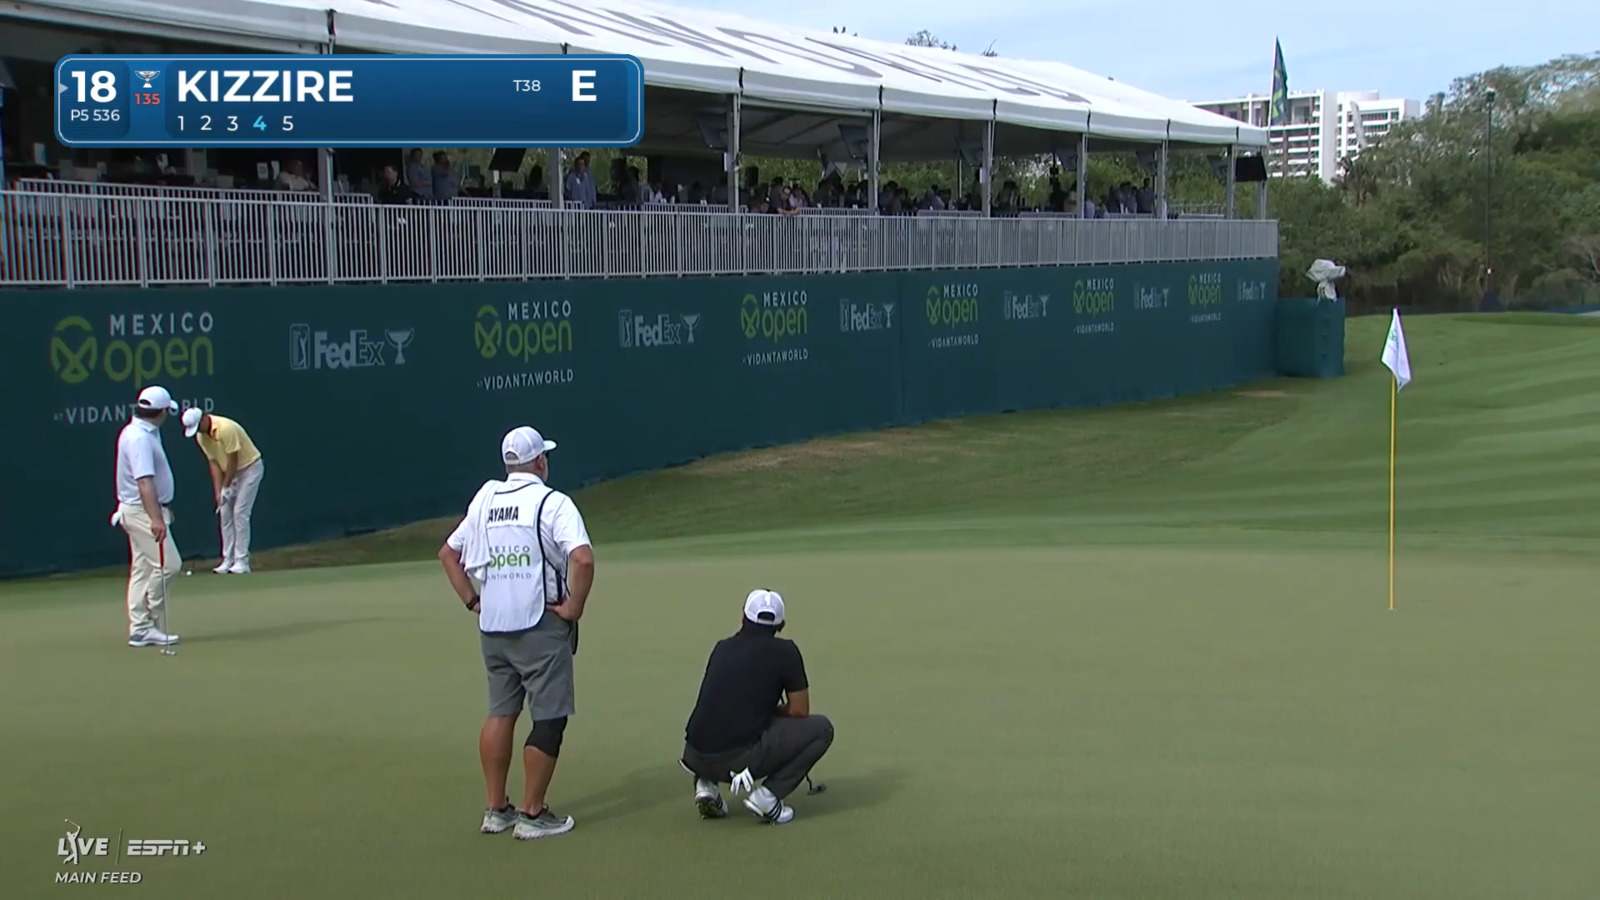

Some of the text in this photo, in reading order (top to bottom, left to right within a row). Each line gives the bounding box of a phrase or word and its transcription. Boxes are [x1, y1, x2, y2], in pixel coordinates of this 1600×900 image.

[763, 290, 807, 307] MEXICO
[943, 284, 978, 298] MEXICO
[508, 300, 571, 320] MEXICO
[942, 298, 978, 328] open
[109, 312, 214, 337] MEXICO
[634, 313, 681, 347] FedEx
[762, 306, 807, 344] open
[314, 329, 386, 369] FedEx
[506, 320, 573, 363] open
[103, 336, 214, 389] open
[747, 348, 809, 366] VIDANTAWORLD
[483, 368, 574, 391] VIDANTAWORLD
